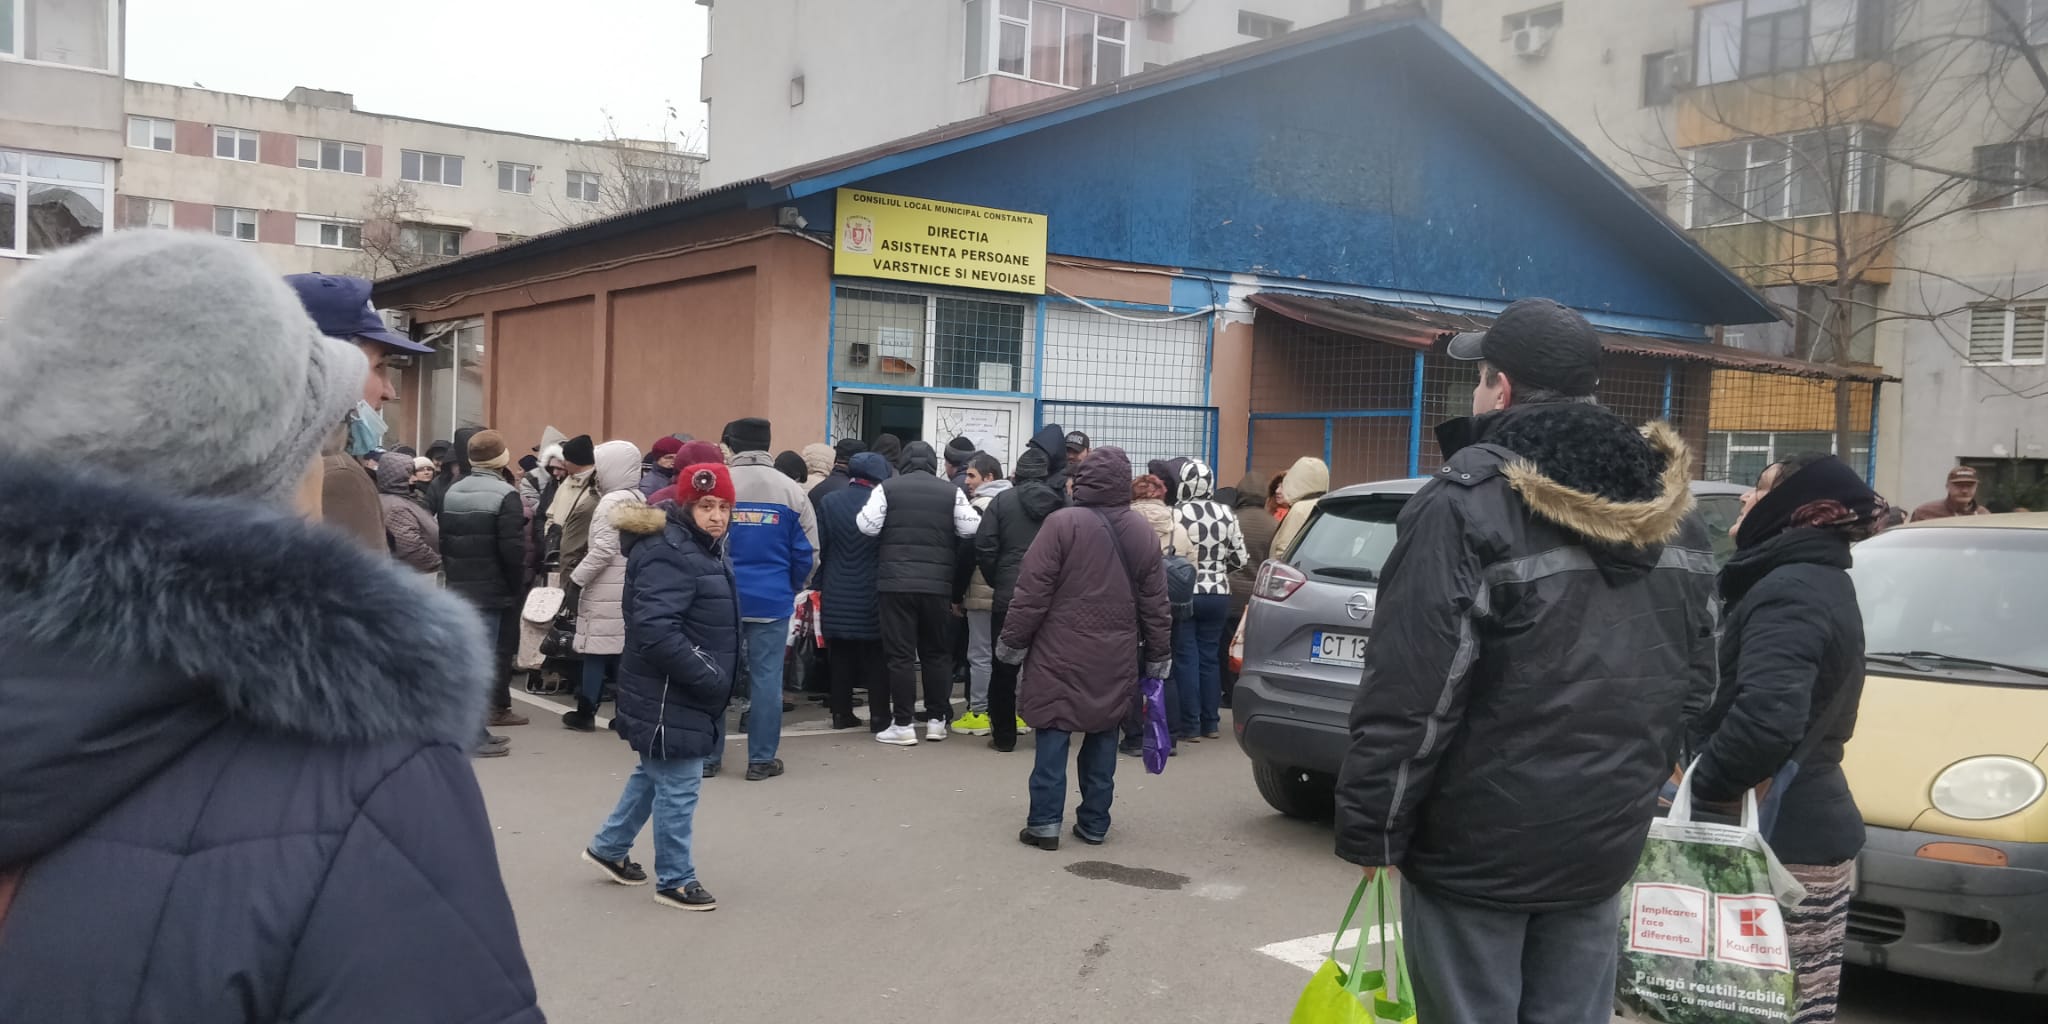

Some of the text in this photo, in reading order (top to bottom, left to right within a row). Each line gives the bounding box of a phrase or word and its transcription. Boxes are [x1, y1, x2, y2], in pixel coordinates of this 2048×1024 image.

[853, 193, 1033, 224] CONSILIUL LOCAL MUNICIPAL CONSTANTA
[927, 225, 989, 243] DIRECTIA
[881, 239, 1029, 266] ASISTENTA PERSOANE
[873, 258, 1036, 286] VARSTNICE SI NEVOIASE
[1322, 635, 1344, 656] CT
[1642, 904, 1697, 918] Implicarea
[1641, 917, 1665, 928] face
[1726, 938, 1783, 956] Kaufland
[1635, 971, 1785, 1006] Pungă reutilizabilă
[1681, 995, 1695, 1005] cu
[1697, 998, 1736, 1012] mediul
